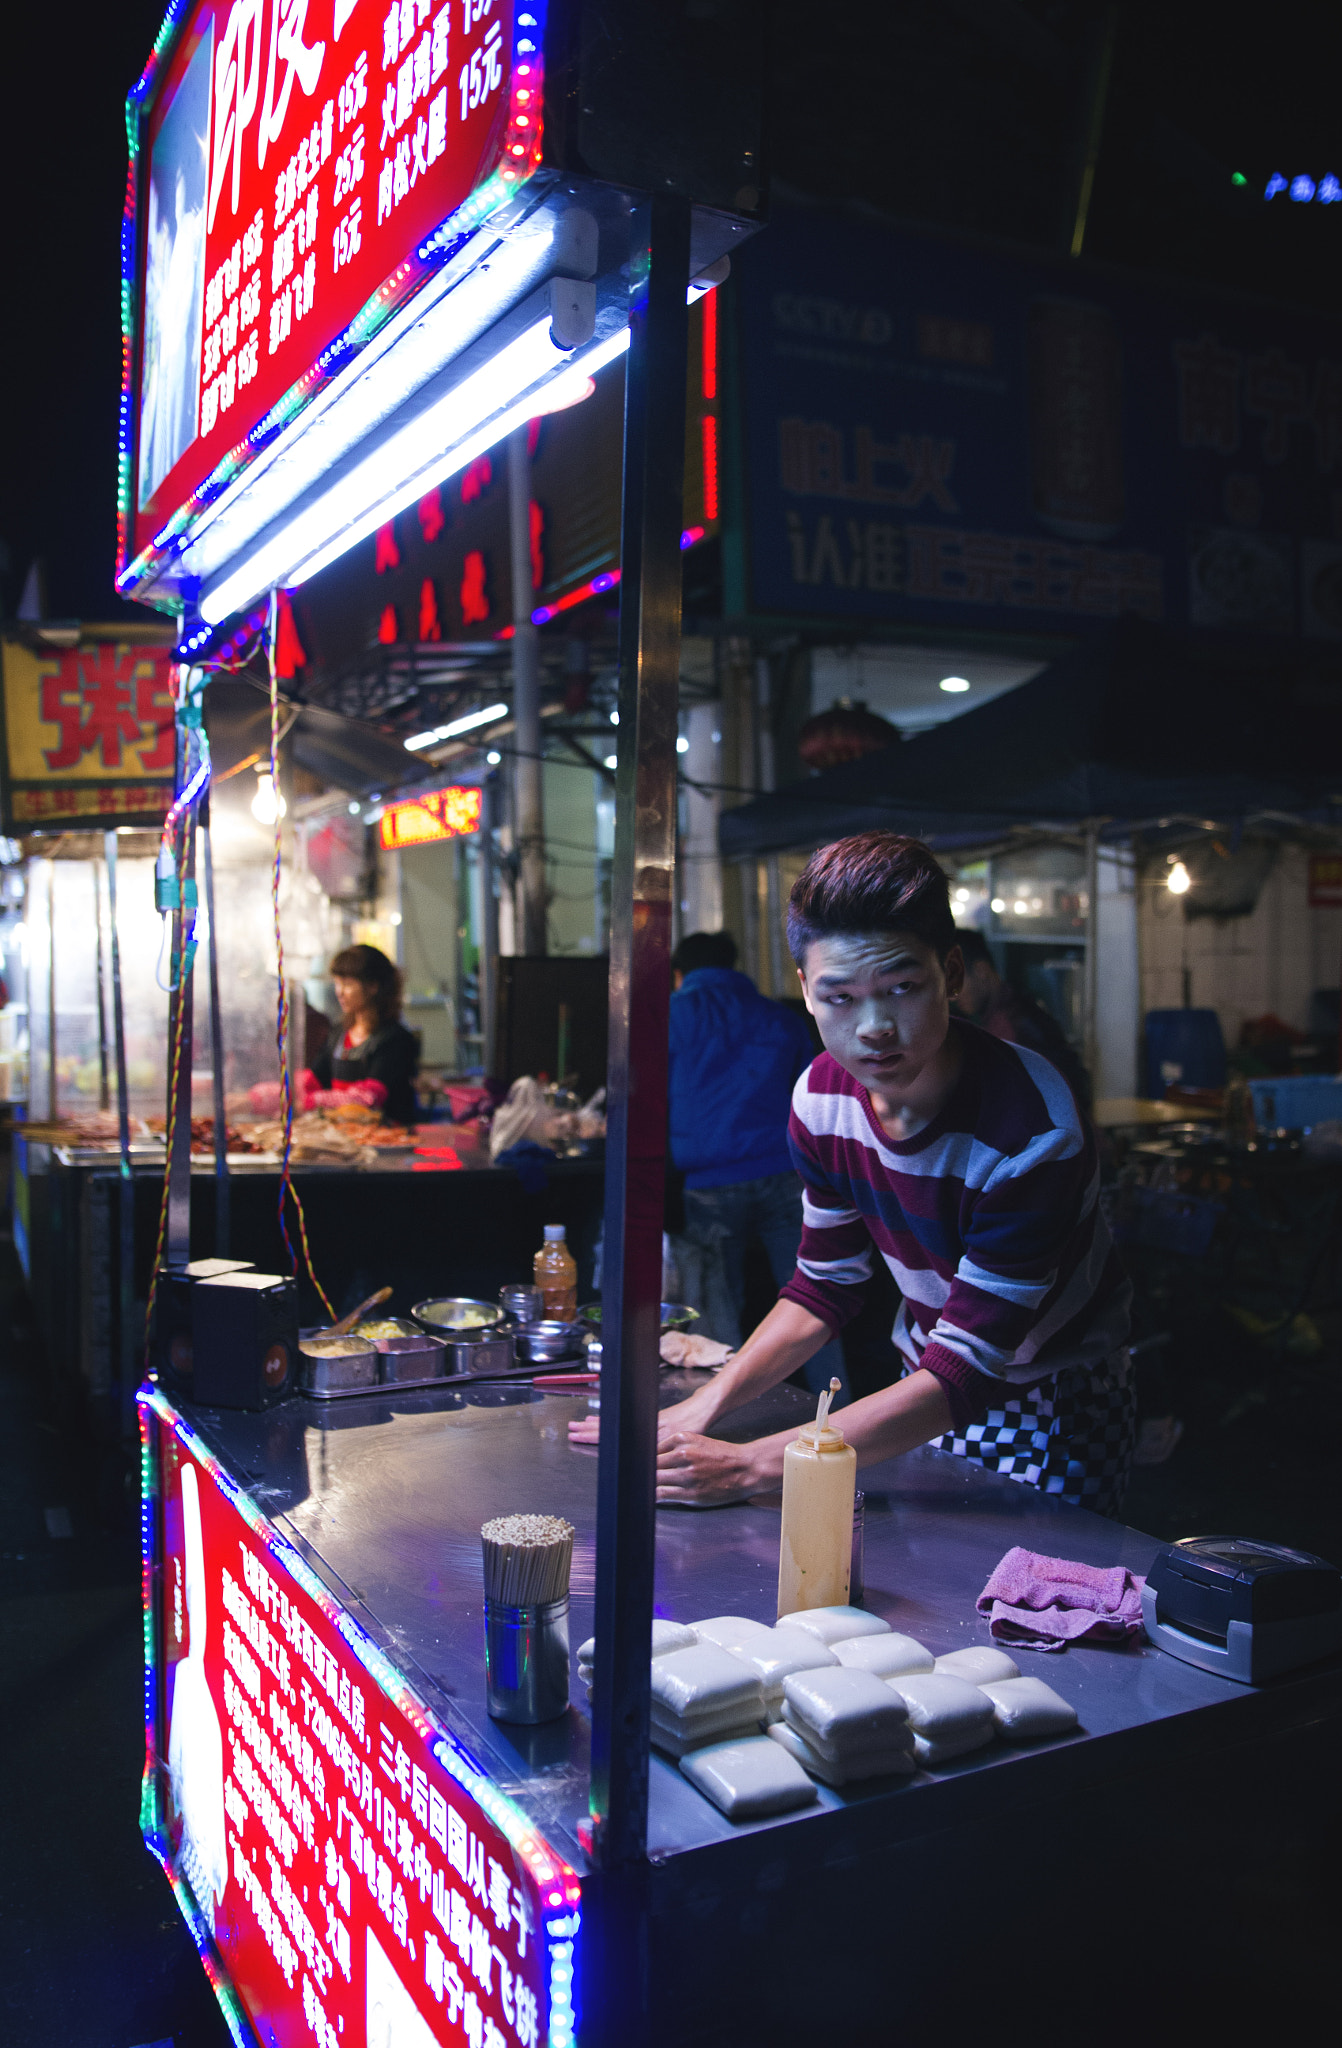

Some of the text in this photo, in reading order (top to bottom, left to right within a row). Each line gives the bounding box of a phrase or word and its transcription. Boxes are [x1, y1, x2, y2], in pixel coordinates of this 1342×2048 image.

[338, 51, 367, 132] 15元
[380, 3, 449, 151] 火腿鸡蛋
[378, 87, 446, 226] 肉松火腿
[460, 21, 501, 120] 15元
[334, 124, 364, 206] 25元
[243, 208, 263, 272] 15元
[331, 197, 361, 273] 15元
[240, 269, 261, 331] 15元
[238, 329, 258, 389] 15元
